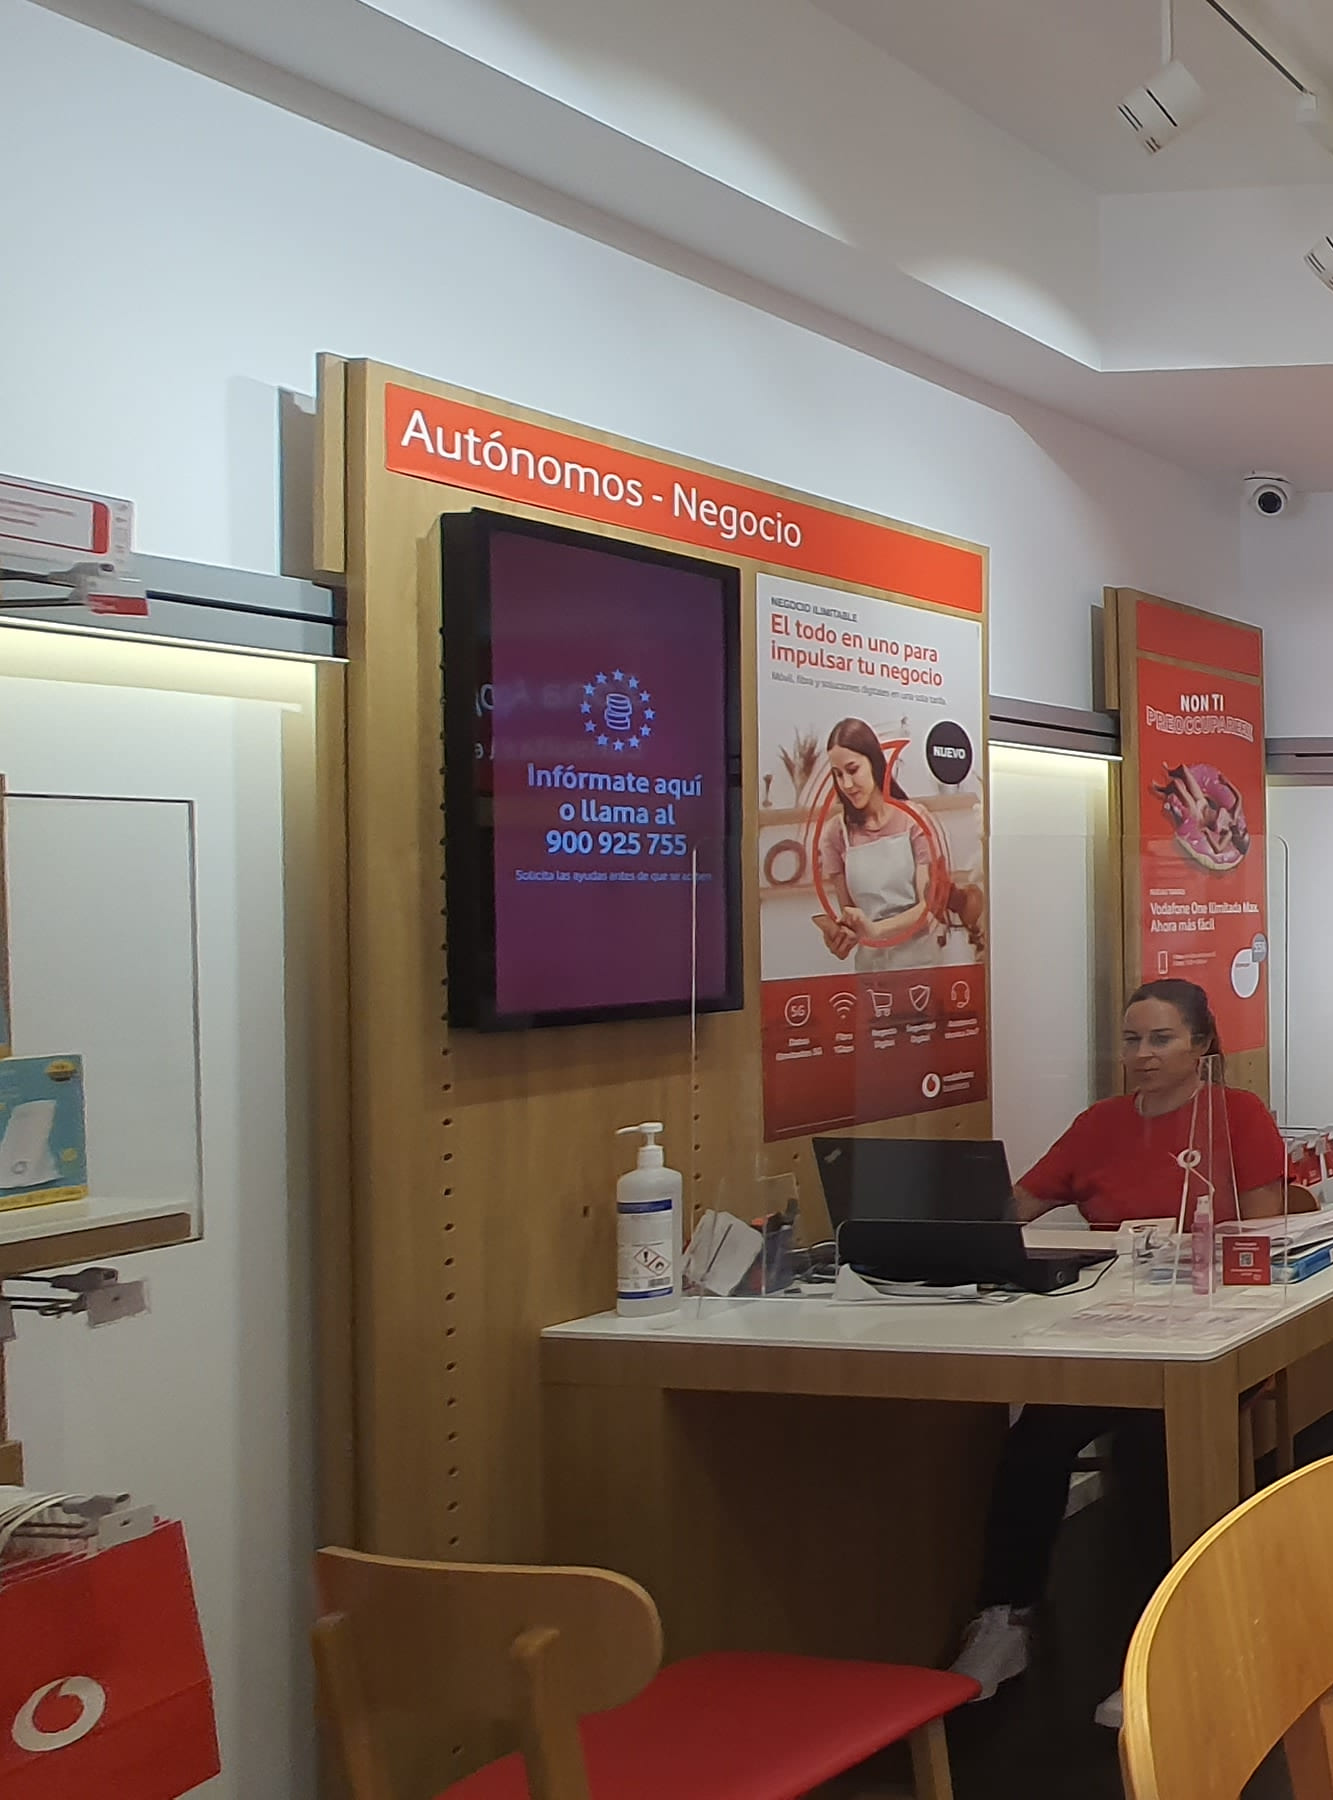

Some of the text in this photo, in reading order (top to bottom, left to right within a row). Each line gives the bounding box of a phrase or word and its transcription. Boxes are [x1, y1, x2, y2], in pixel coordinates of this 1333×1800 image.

[401, 409, 645, 507] Autónomos
[671, 482, 803, 549] Negocio
[771, 597, 811, 614] NEGOCIO
[771, 613, 938, 663] El todo en uno para
[771, 640, 943, 687] impulsar tu negocio
[1181, 693, 1225, 712] NON TI
[933, 745, 966, 759] NUEVO
[528, 763, 703, 801] Infórmate aquí
[559, 799, 676, 825] o llama al
[546, 830, 688, 857] 900 925 755
[1150, 902, 1190, 915] Vodafone
[1191, 901, 1208, 914] One
[1151, 919, 1177, 932] Ahora
[1179, 918, 1197, 931] más
